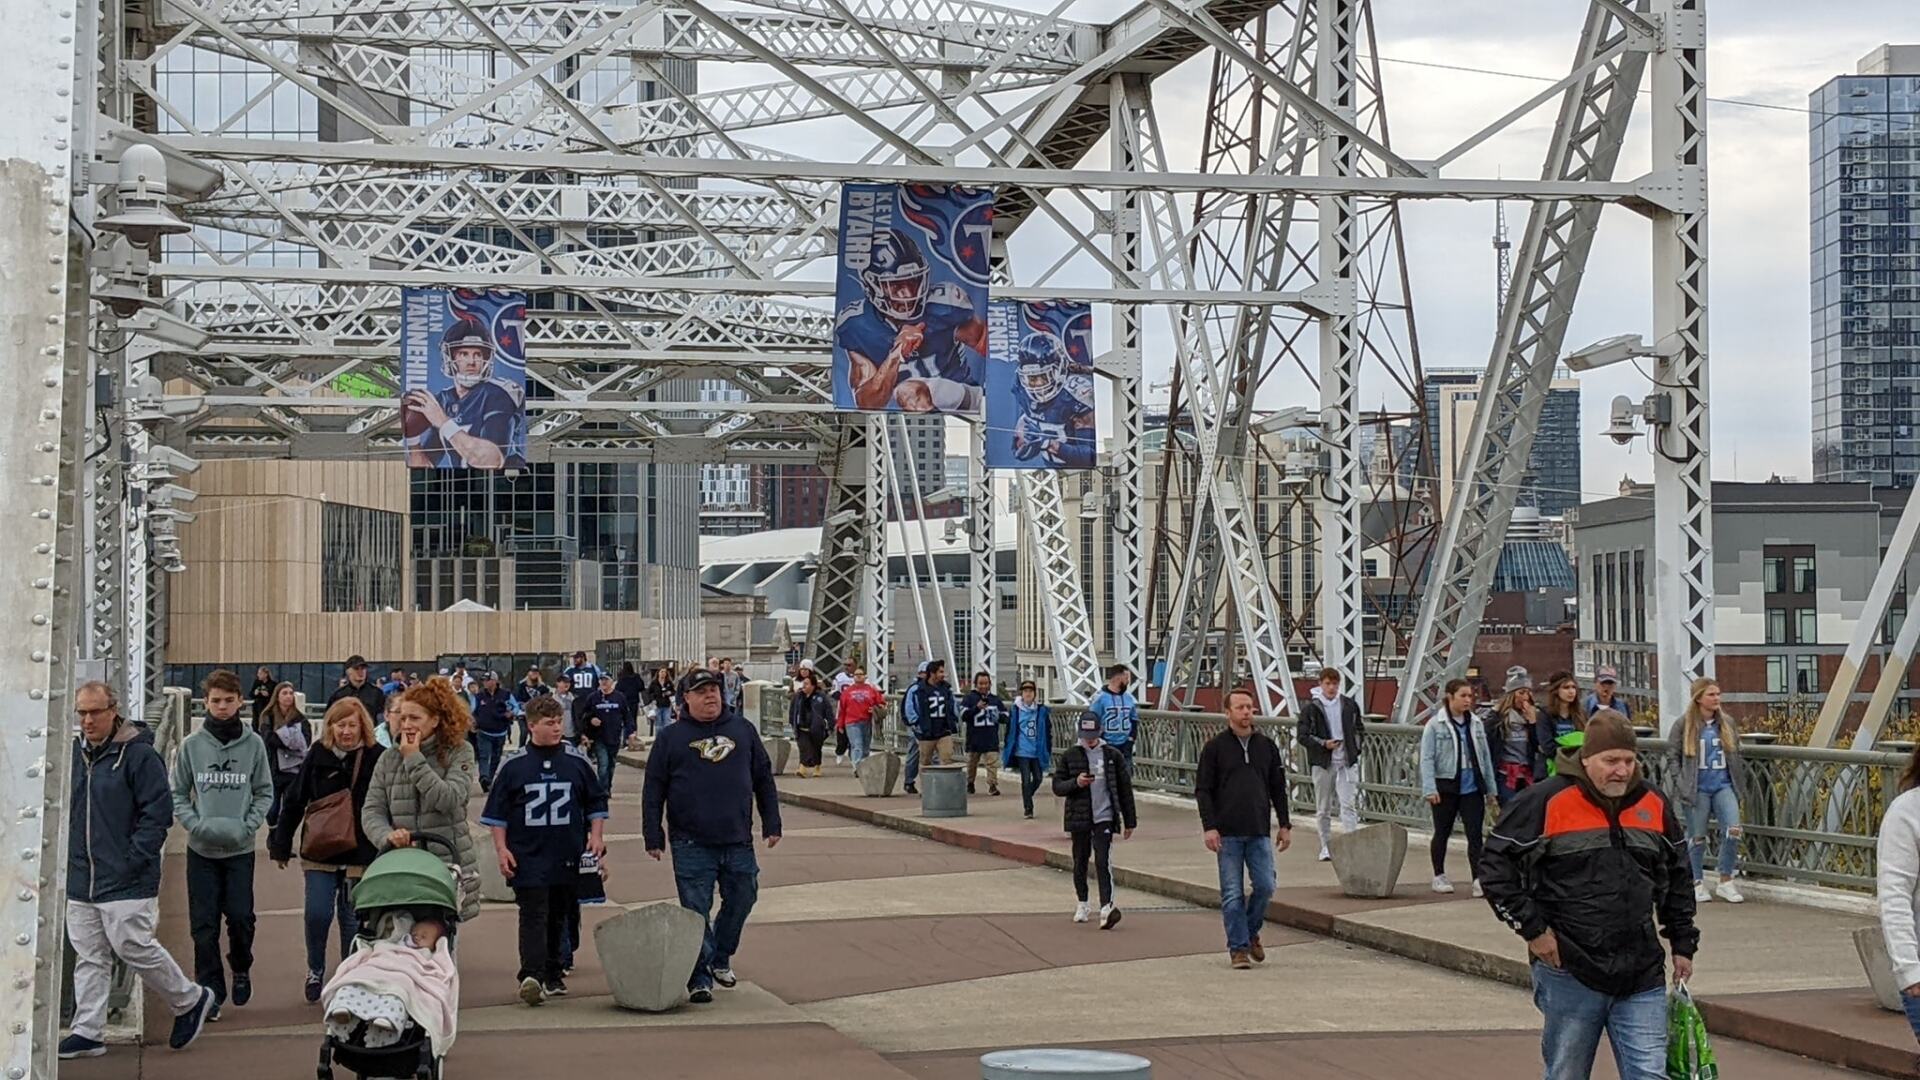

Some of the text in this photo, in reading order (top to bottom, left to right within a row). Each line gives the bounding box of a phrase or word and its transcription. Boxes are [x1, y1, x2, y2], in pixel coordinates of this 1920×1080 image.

[844, 192, 875, 270] BYARD
[873, 192, 893, 245] KEVIN
[428, 294, 443, 333] RYAN
[987, 305, 1009, 362] HENRY
[1006, 305, 1020, 362] DERRICK
[573, 672, 593, 688] 90
[928, 696, 946, 718] 22
[1104, 706, 1132, 733] 22
[1699, 738, 1727, 769] 13
[197, 772, 247, 785] HOLLISTER
[524, 782, 572, 827] 22
